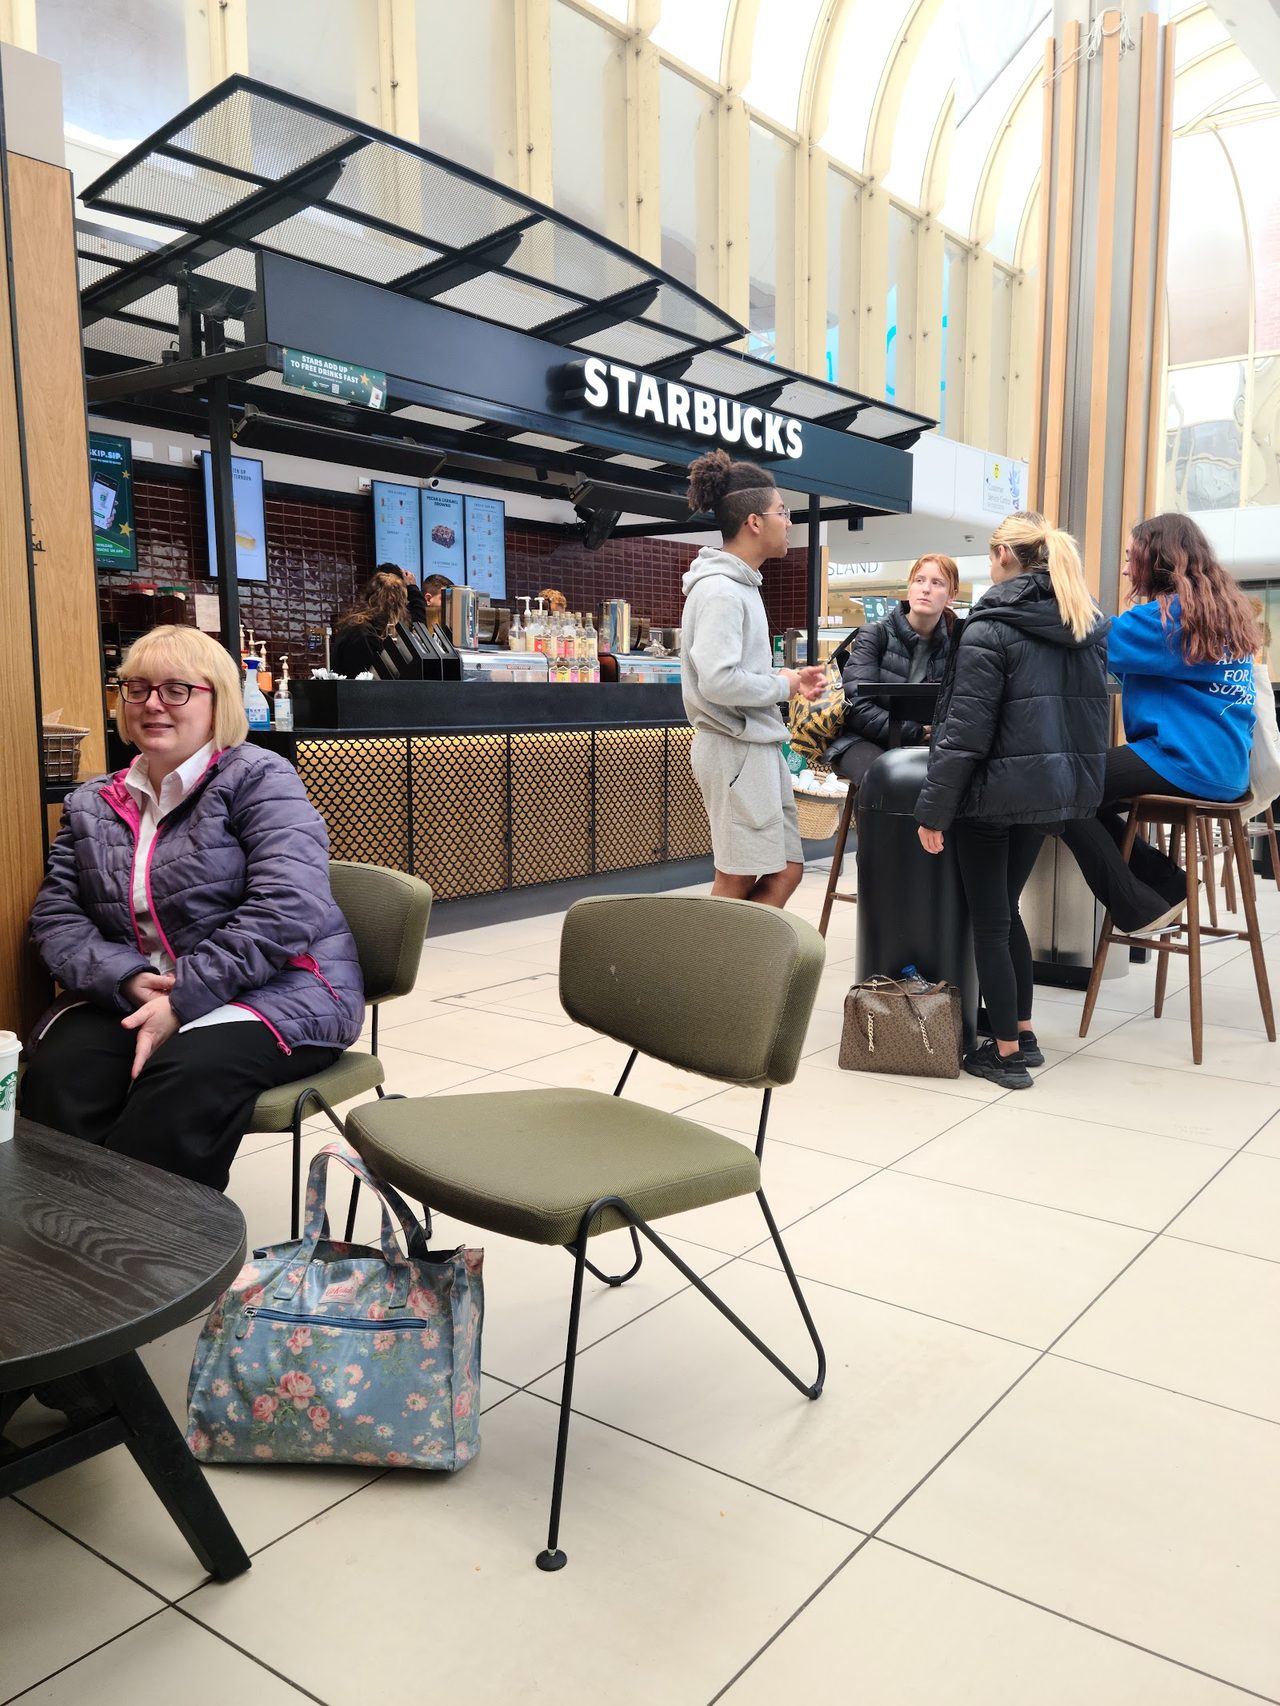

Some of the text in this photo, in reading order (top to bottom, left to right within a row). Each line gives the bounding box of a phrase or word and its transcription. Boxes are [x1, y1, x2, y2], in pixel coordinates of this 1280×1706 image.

[290, 359, 300, 368] TO
[301, 363, 317, 373] FREE
[318, 368, 343, 380] DRINKS
[343, 374, 359, 384] FAST
[302, 355, 348, 373] STARS ADD UP
[584, 357, 803, 459] STARBUCKS
[1224, 669, 1250, 682] FOR
